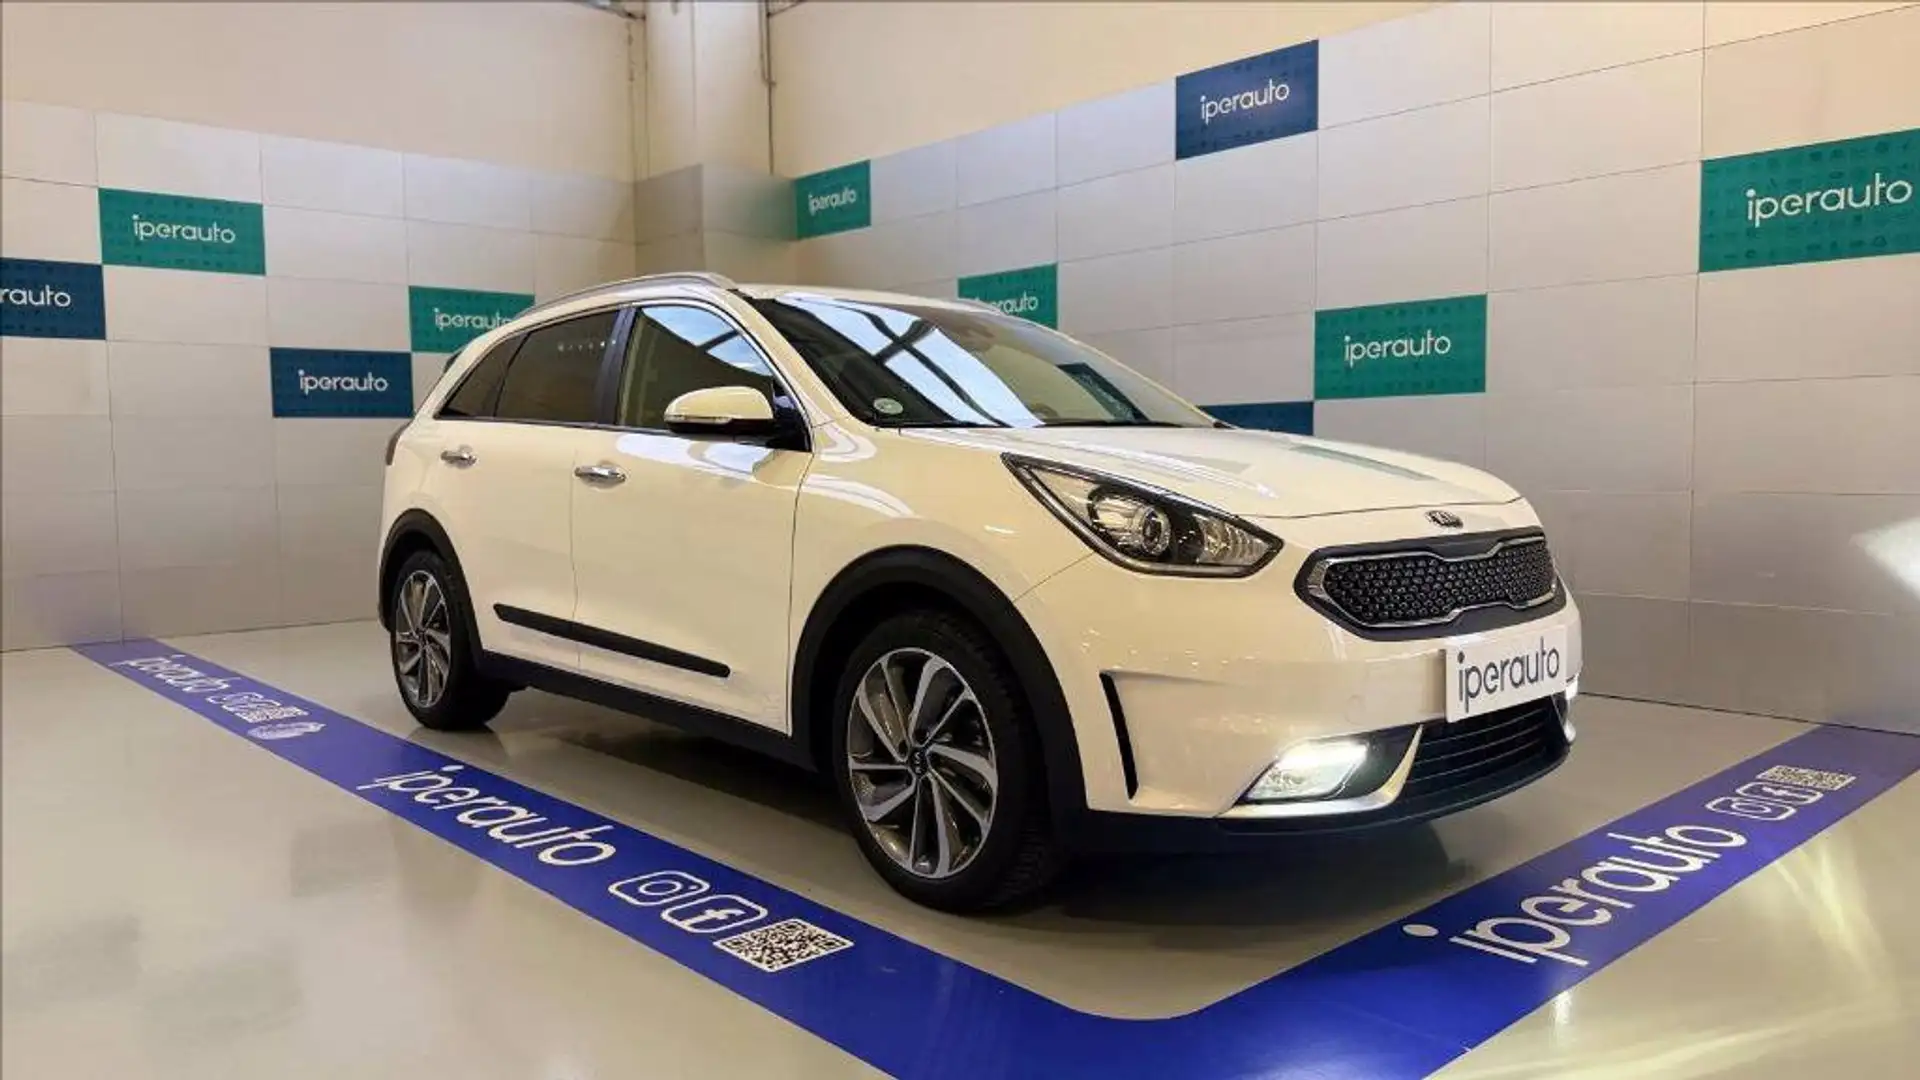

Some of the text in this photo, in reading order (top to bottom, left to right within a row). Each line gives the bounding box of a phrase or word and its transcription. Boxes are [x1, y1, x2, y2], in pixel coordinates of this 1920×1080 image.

[1199, 78, 1291, 124] iperauto
[807, 187, 857, 217] iperauto
[1745, 172, 1912, 227] iperauto
[132, 214, 236, 244] iperauto
[1343, 329, 1451, 367] iperauto
[298, 369, 388, 395] iperauto
[1457, 635, 1560, 713] iperauto
[356, 764, 616, 866] iperauto
[1402, 824, 1747, 966] iperauto
